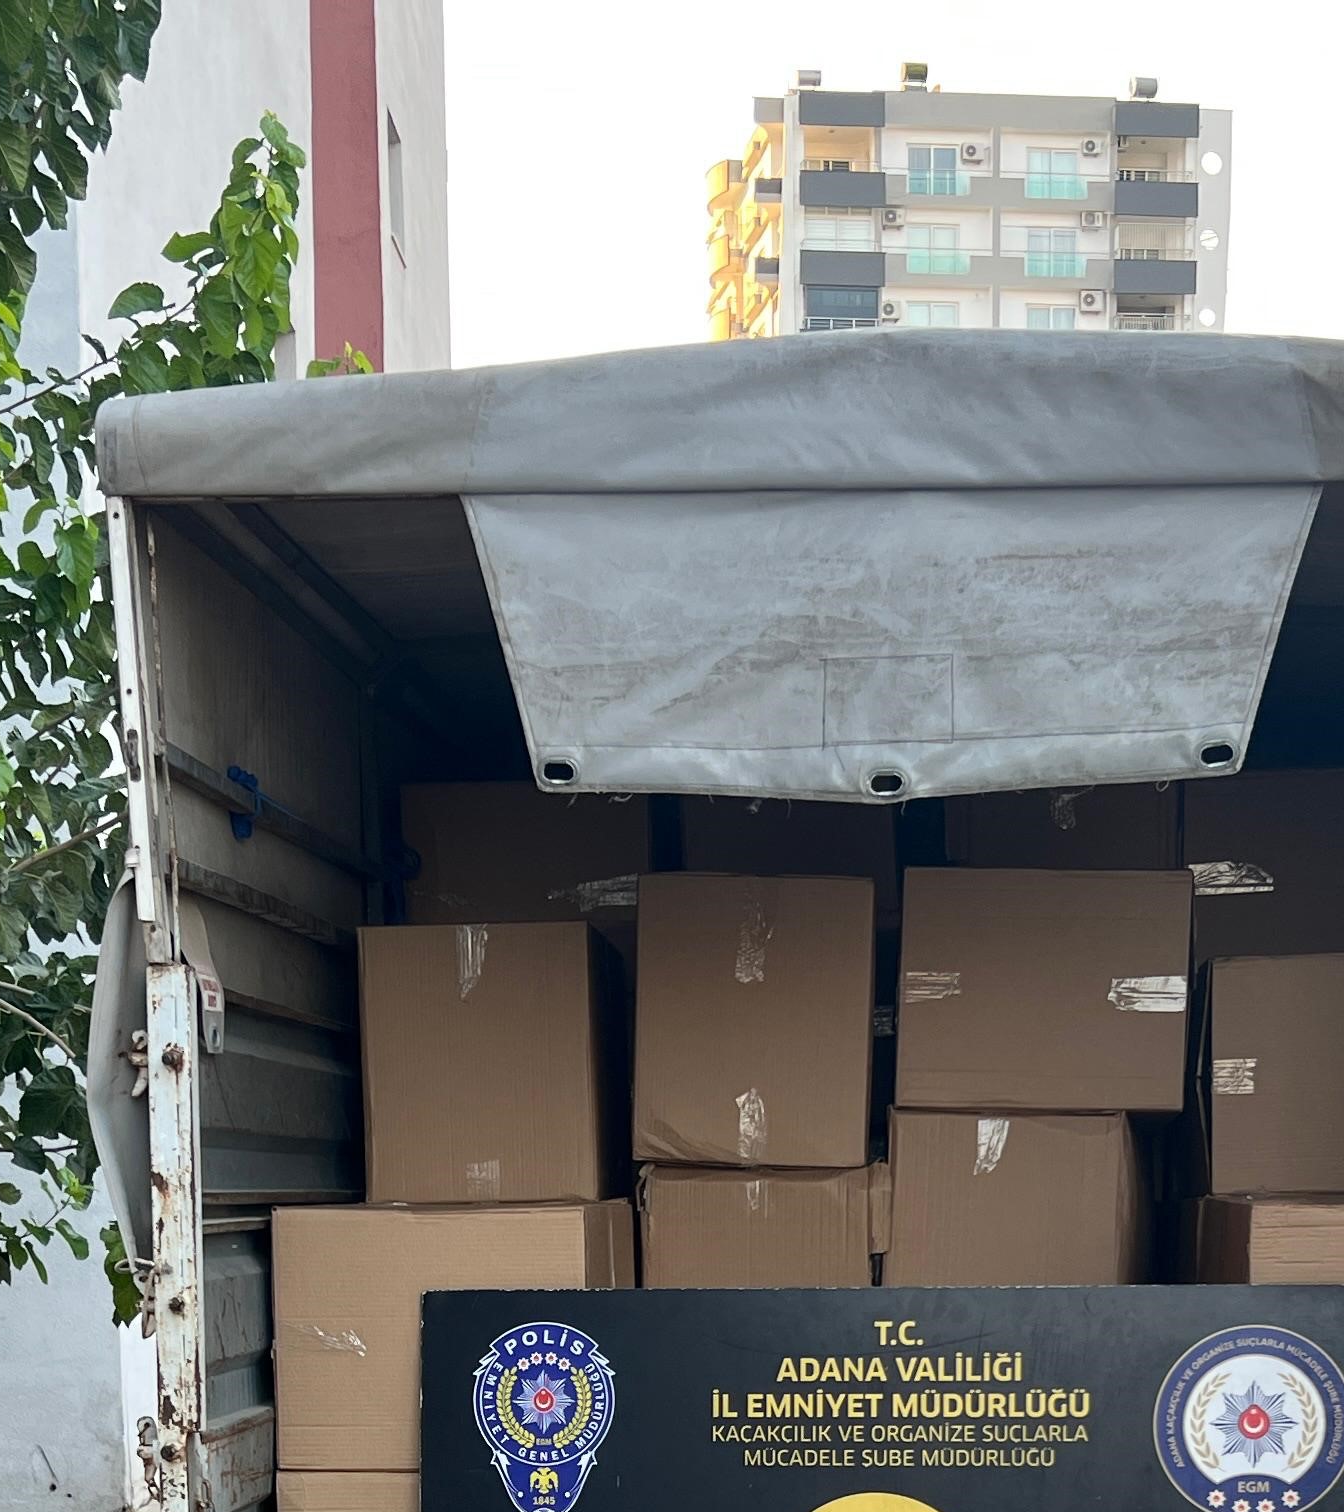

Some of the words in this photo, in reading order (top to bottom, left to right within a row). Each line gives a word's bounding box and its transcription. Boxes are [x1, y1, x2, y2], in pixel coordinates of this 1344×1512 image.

[504, 1329, 585, 1356] POLİS
[873, 1320, 924, 1346] T.C.
[776, 1357, 887, 1382] ADANA
[895, 1351, 1023, 1382] VALİLİĞİ
[712, 1388, 738, 1418] İL
[747, 1388, 884, 1418] EMNİYET
[892, 1388, 1091, 1419] MÜDÜRLÜĞÜ
[712, 1424, 832, 1443] KAÇAKÇILIK
[838, 1424, 865, 1442] VE
[871, 1421, 976, 1442] ORGANİZE
[982, 1424, 1090, 1443] SUÇLARLA
[518, 1447, 570, 1462] GENEL
[743, 1446, 856, 1467] MÜCADELE
[861, 1448, 916, 1468] ŞUBE
[922, 1446, 1056, 1468] MÜDÜRLÜĞÜ
[1237, 1480, 1271, 1493] EGM
[532, 1495, 556, 1506] 1845
